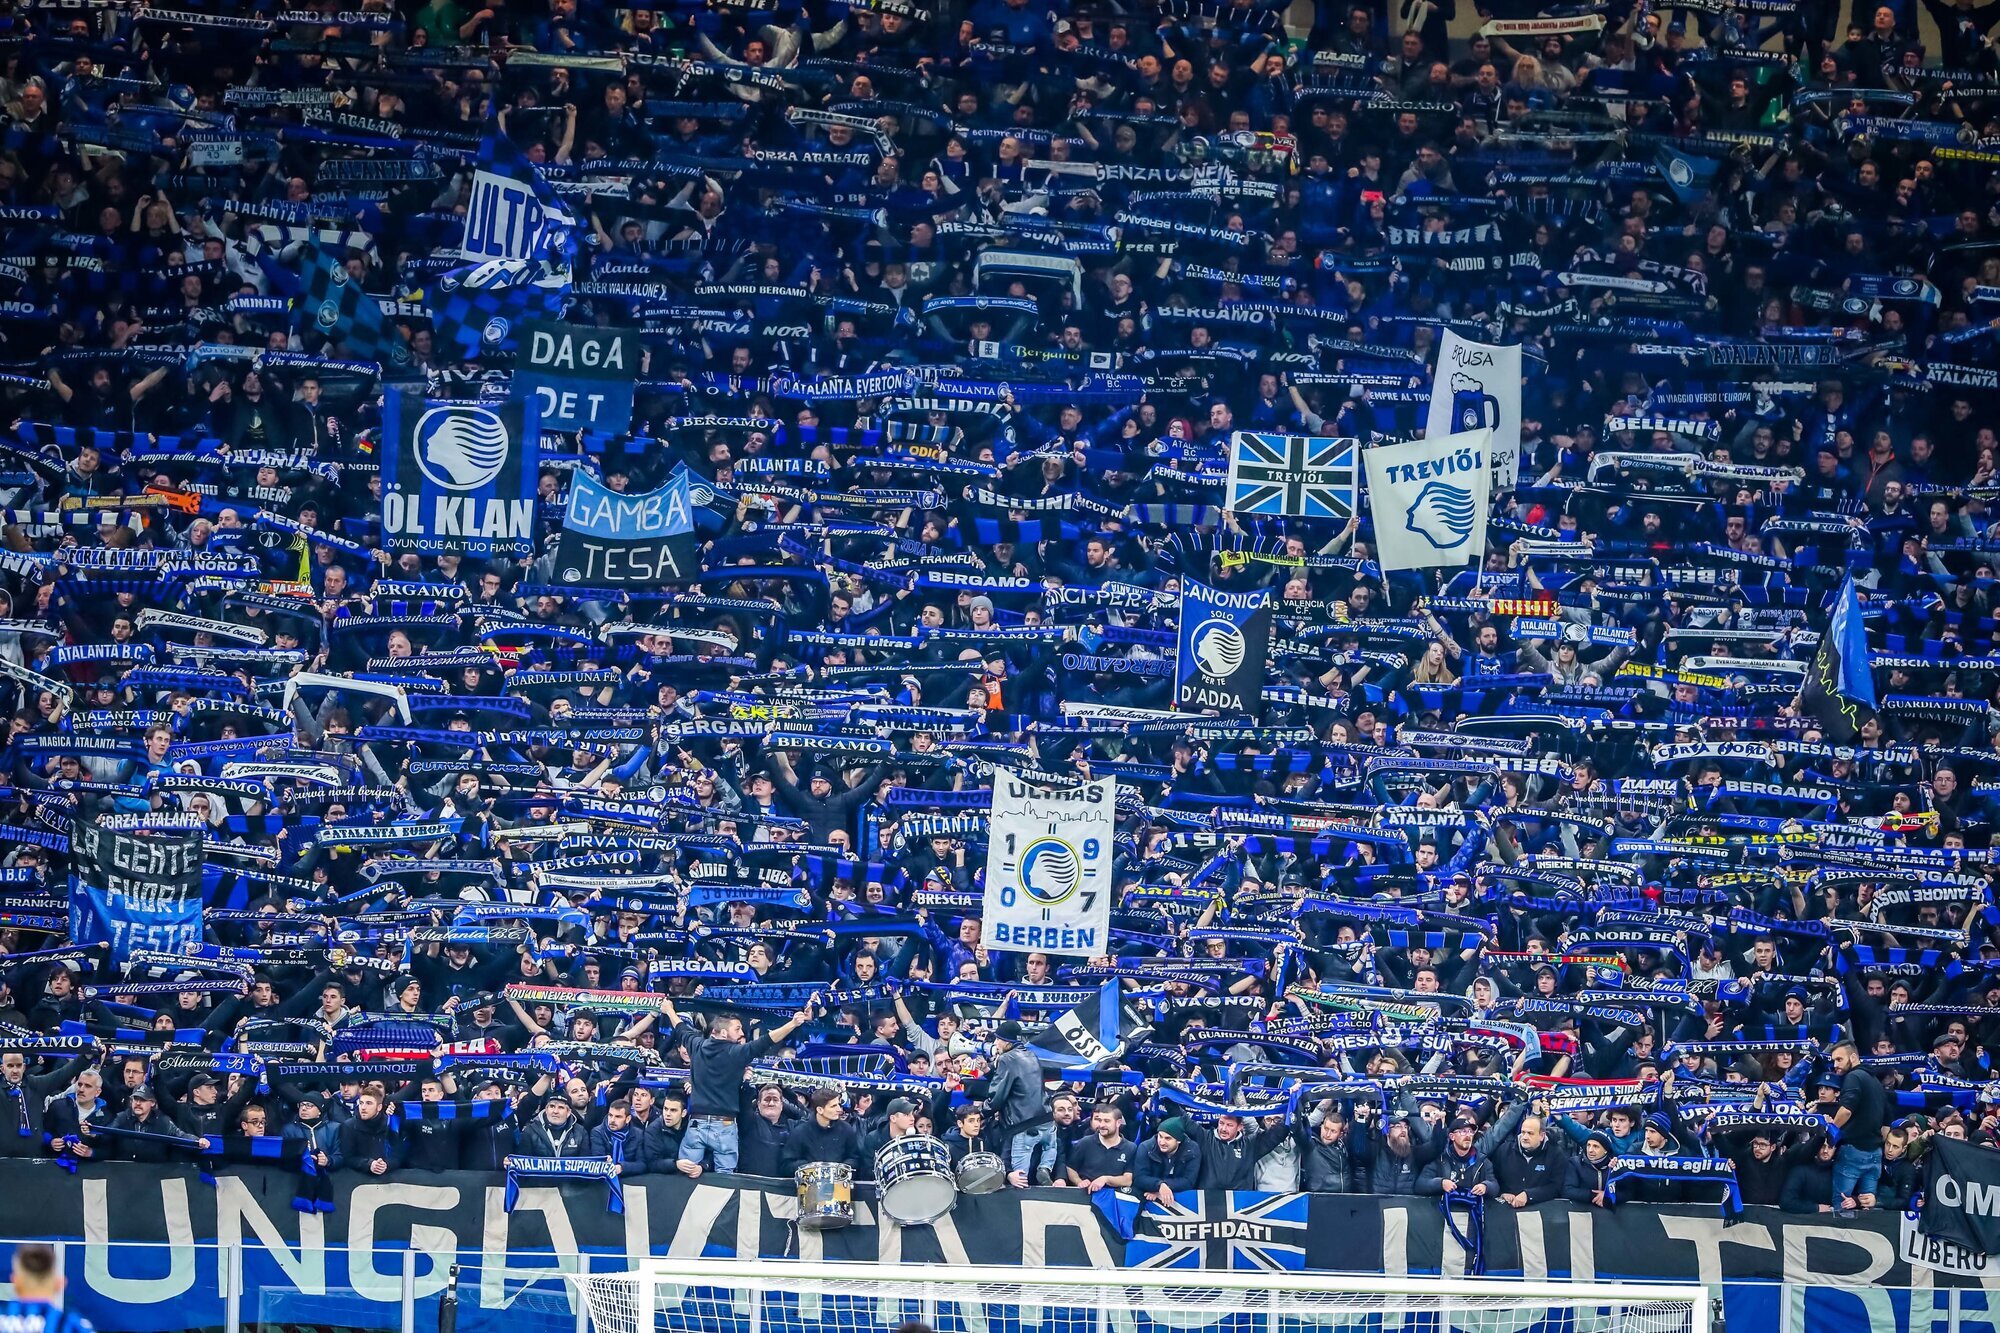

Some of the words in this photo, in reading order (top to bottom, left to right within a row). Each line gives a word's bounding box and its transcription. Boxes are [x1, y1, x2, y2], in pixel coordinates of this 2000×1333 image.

[1899, 67, 1928, 77] FORZA
[1932, 71, 1973, 81] ATALANTA
[1367, 100, 1455, 112] BERGAMO
[1856, 118, 1896, 130] ATALANTA
[1898, 125, 1910, 133] VS
[1706, 131, 1774, 146] ATALANTA
[312, 192, 346, 203] ROMA
[605, 283, 630, 296] WALK
[633, 284, 659, 300] ALONE
[695, 285, 724, 295] CURVA
[727, 285, 756, 295] NORD
[759, 285, 806, 297] BERGAMO
[531, 331, 623, 369] DAGA
[1010, 344, 1080, 360] Bergamo
[1452, 345, 1494, 367] BRUSA
[792, 375, 853, 395] ATALANTA
[856, 374, 902, 393] EVERTON
[1139, 376, 1155, 385] VS
[1927, 370, 1997, 387] ATALANTA
[939, 383, 996, 395] ATALANTA
[1667, 394, 1693, 403] VIAGGIO
[1696, 393, 1717, 402] VERSO
[683, 417, 768, 428] BERGAMO
[1609, 418, 1706, 435] BELLINI
[348, 462, 379, 470] NORD
[804, 460, 828, 474] B.C.
[1154, 465, 1186, 480] SEMPRE
[1188, 476, 1199, 485] AL
[1201, 478, 1220, 487] TUO
[979, 488, 1072, 509] BELLINI
[385, 482, 424, 533] ÖL
[435, 497, 534, 538] KLAN
[570, 485, 687, 532] GAMBA
[261, 511, 359, 547] BERGAMO
[387, 539, 443, 551] OVUNQUE
[445, 541, 458, 551] AL
[462, 542, 486, 552] TUO
[490, 543, 530, 554] FIANCO
[69, 548, 112, 567] FORZA
[114, 549, 177, 569] ATALANTA
[1707, 547, 1744, 561] Lunga
[193, 561, 236, 572] NORD
[583, 543, 680, 580] TESA
[929, 572, 1029, 587] BERGAMO
[1283, 599, 1324, 608] VALENCIA
[1432, 598, 1484, 608] ATALANTA
[1211, 611, 1233, 619] SOLO
[1295, 607, 1311, 615] C.F.
[1520, 621, 1557, 630] ATALANTA
[1593, 627, 1628, 638] ATALANTA
[816, 634, 844, 646] vita
[864, 639, 912, 649] ultras
[58, 646, 118, 662] ATALANTA
[121, 647, 144, 661] B.C.
[1876, 657, 1929, 667] BRESCIA
[1938, 660, 1949, 669] TI
[1958, 660, 1994, 669] ODIO
[556, 672, 569, 682] DI
[574, 672, 597, 681] UNA
[1201, 675, 1216, 684] PER
[1218, 677, 1225, 685] TE
[1183, 686, 1243, 710] D'ADDA
[196, 698, 292, 725] BERGAMO
[1887, 700, 1944, 710] GUARDIA
[1946, 702, 1956, 710] DI
[1960, 702, 1983, 712] UNA
[72, 711, 139, 723] ATALANTA
[146, 711, 174, 722] 1907
[587, 728, 644, 739] NORD
[782, 722, 813, 731] NUOVA
[39, 737, 71, 748] MAGICA
[74, 738, 116, 750] ATALANTA
[210, 743, 244, 755] CAGA
[780, 736, 881, 752] BERGAMO
[164, 777, 262, 794] BERGAMO
[328, 788, 359, 796] nord
[1621, 780, 1677, 791] ATALANTA
[1726, 781, 1832, 800] BERGAMO
[1221, 811, 1284, 825] ATALANTA
[1389, 813, 1466, 826] ATALANTA
[1515, 808, 1548, 816] NORD
[1551, 811, 1603, 826] BERGAMO
[904, 818, 979, 836] ATALANTA
[560, 835, 618, 849] CURVA
[1005, 834, 1014, 854] 1
[1084, 839, 1098, 859] 9
[530, 852, 635, 872] BERGAMO
[1572, 862, 1589, 871] PER
[1597, 864, 1634, 879] SEMPRE
[918, 893, 972, 905] BRESCIA
[1081, 891, 1096, 912] 7
[415, 928, 483, 940] Atalanta
[489, 929, 520, 939] B.C.
[997, 921, 1095, 949] BERBÈN
[1595, 932, 1651, 942] NORD
[650, 961, 748, 973] BERGAMO
[1624, 976, 1683, 992] Atalanta
[1687, 983, 1715, 994] B.C.
[542, 990, 574, 1001] NEVER
[592, 994, 625, 1004] WALK
[627, 996, 663, 1007] ALONE
[1580, 992, 1682, 1004] BERGAMO
[1267, 1014, 1339, 1030] ATALANTA
[1343, 1011, 1373, 1020] 1907
[1587, 1007, 1641, 1025] NORD
[1199, 1030, 1248, 1042] GUARDIA
[1267, 1035, 1289, 1045] UNA
[1692, 1043, 1796, 1053] BERGAMO
[160, 1055, 220, 1069] Atalanta
[280, 1066, 341, 1074] DIFFIDATI
[357, 1065, 416, 1073] OVUNQUE
[1549, 1095, 1596, 1110] SEMPER
[1598, 1094, 1609, 1106] IN
[1716, 1116, 1819, 1128] BERGAMO
[512, 1157, 560, 1171] ATALANTA
[1650, 1158, 1674, 1169] vita
[1675, 1159, 1704, 1173] agli
[1162, 1222, 1272, 1241] DIFFIDATI
